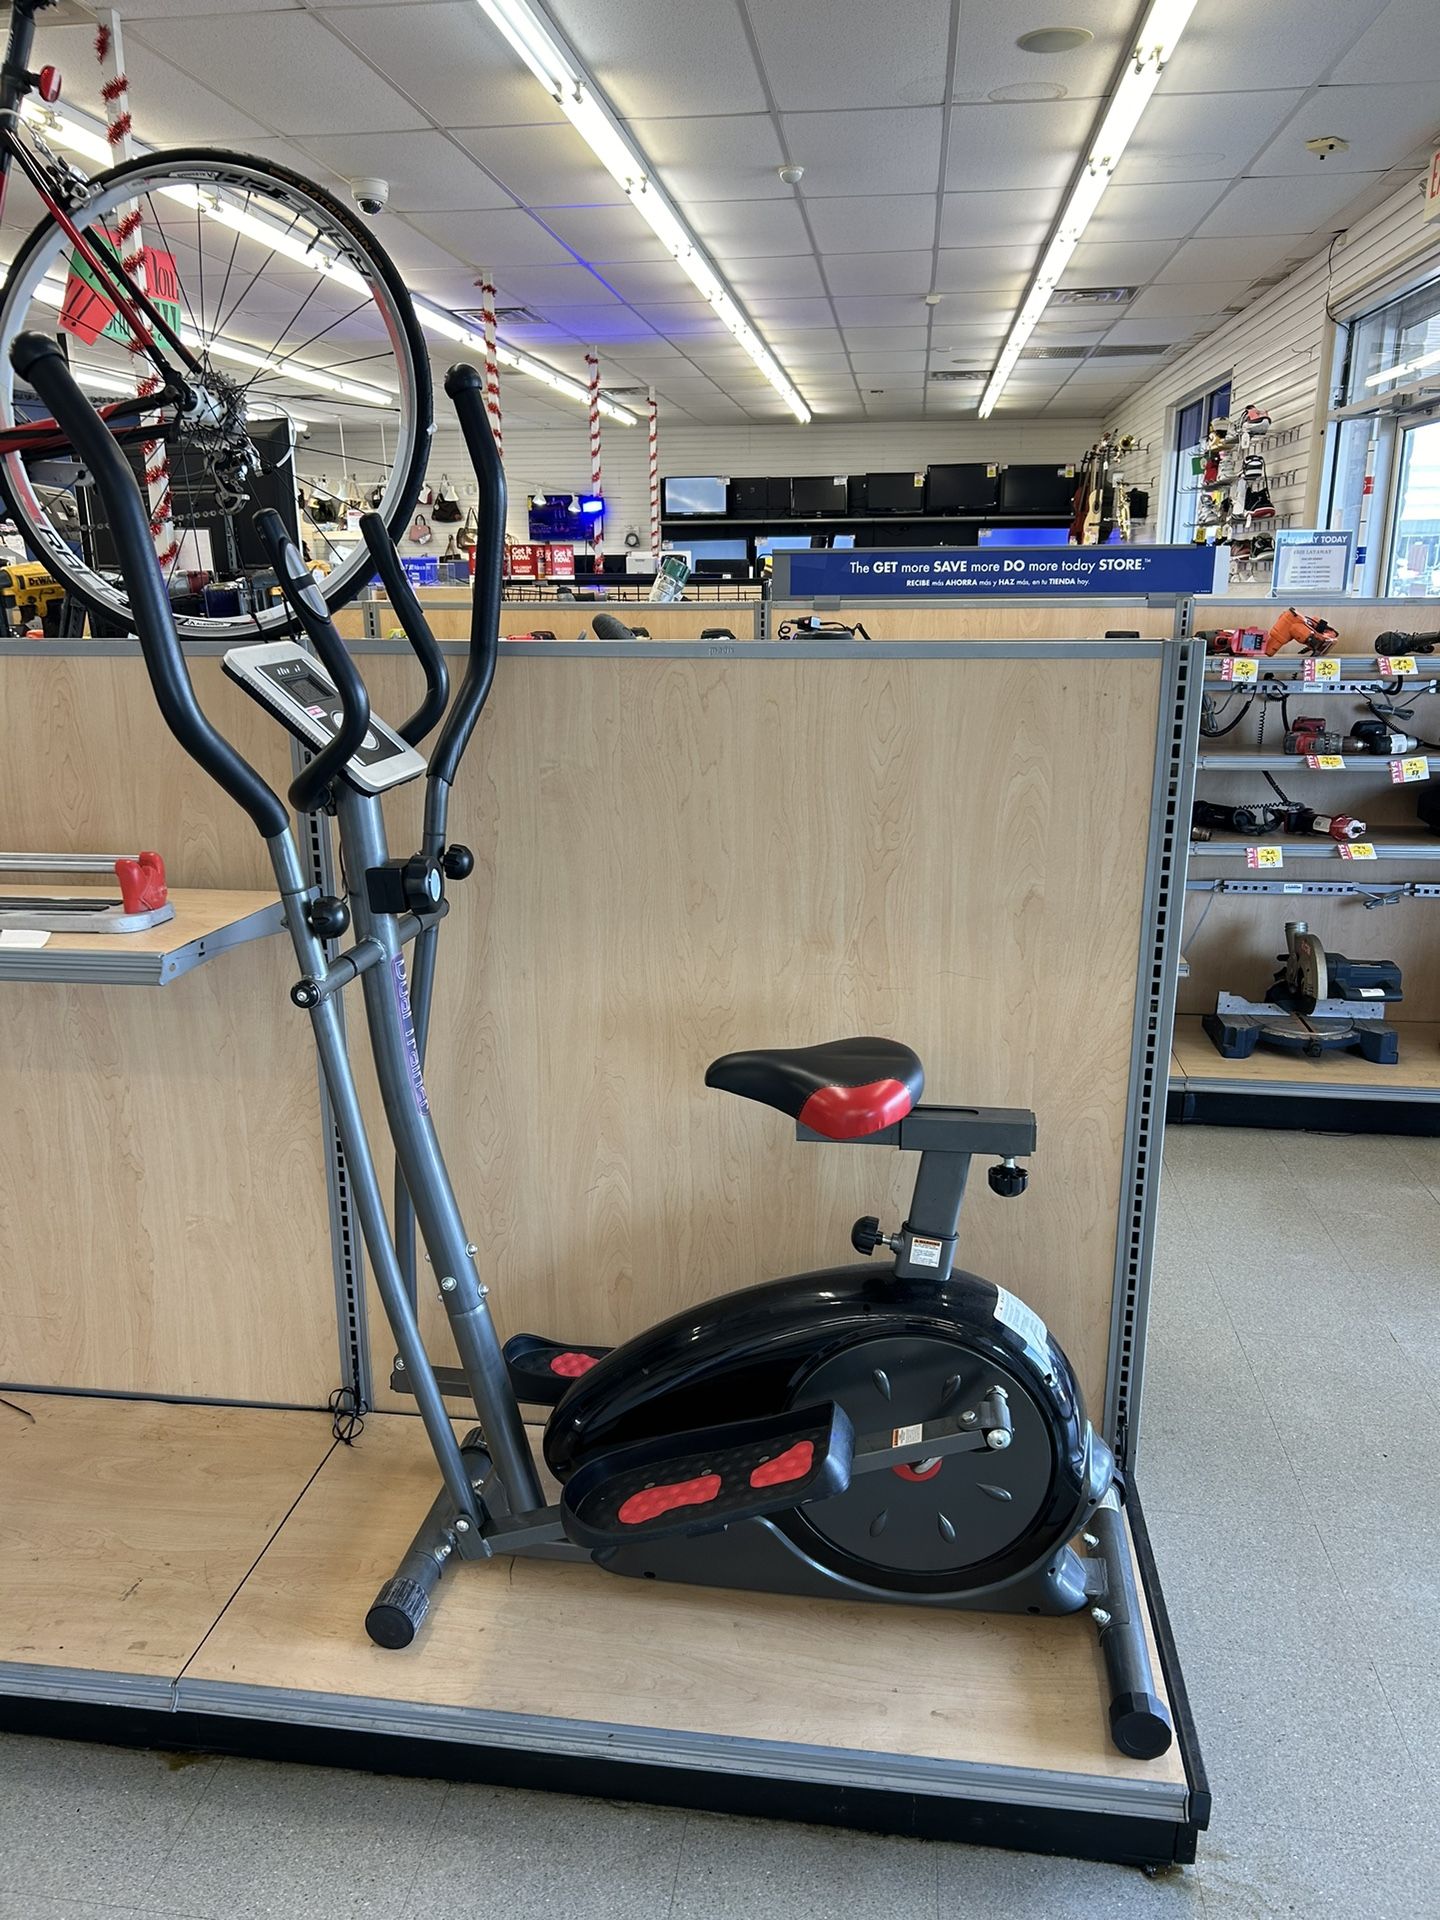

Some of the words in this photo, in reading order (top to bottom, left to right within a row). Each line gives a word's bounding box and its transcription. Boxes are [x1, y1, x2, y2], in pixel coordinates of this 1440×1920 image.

[1321, 535, 1348, 544] TODAY
[511, 546, 525, 556] Get
[850, 561, 870, 574] The
[873, 561, 898, 574] GET
[901, 564, 930, 573] more
[933, 560, 968, 573] SAVE
[971, 563, 1000, 572] more
[1003, 560, 1025, 572] DO
[1028, 562, 1058, 571] more
[1061, 558, 1095, 574] today
[906, 579, 930, 587] RECIBE
[945, 578, 978, 587] AHORRA
[998, 578, 1015, 586] HAZ
[1076, 577, 1091, 587] hoy.
[1221, 658, 1231, 681] SALE
[1304, 659, 1312, 682] SALE
[1391, 761, 1401, 784] SALE
